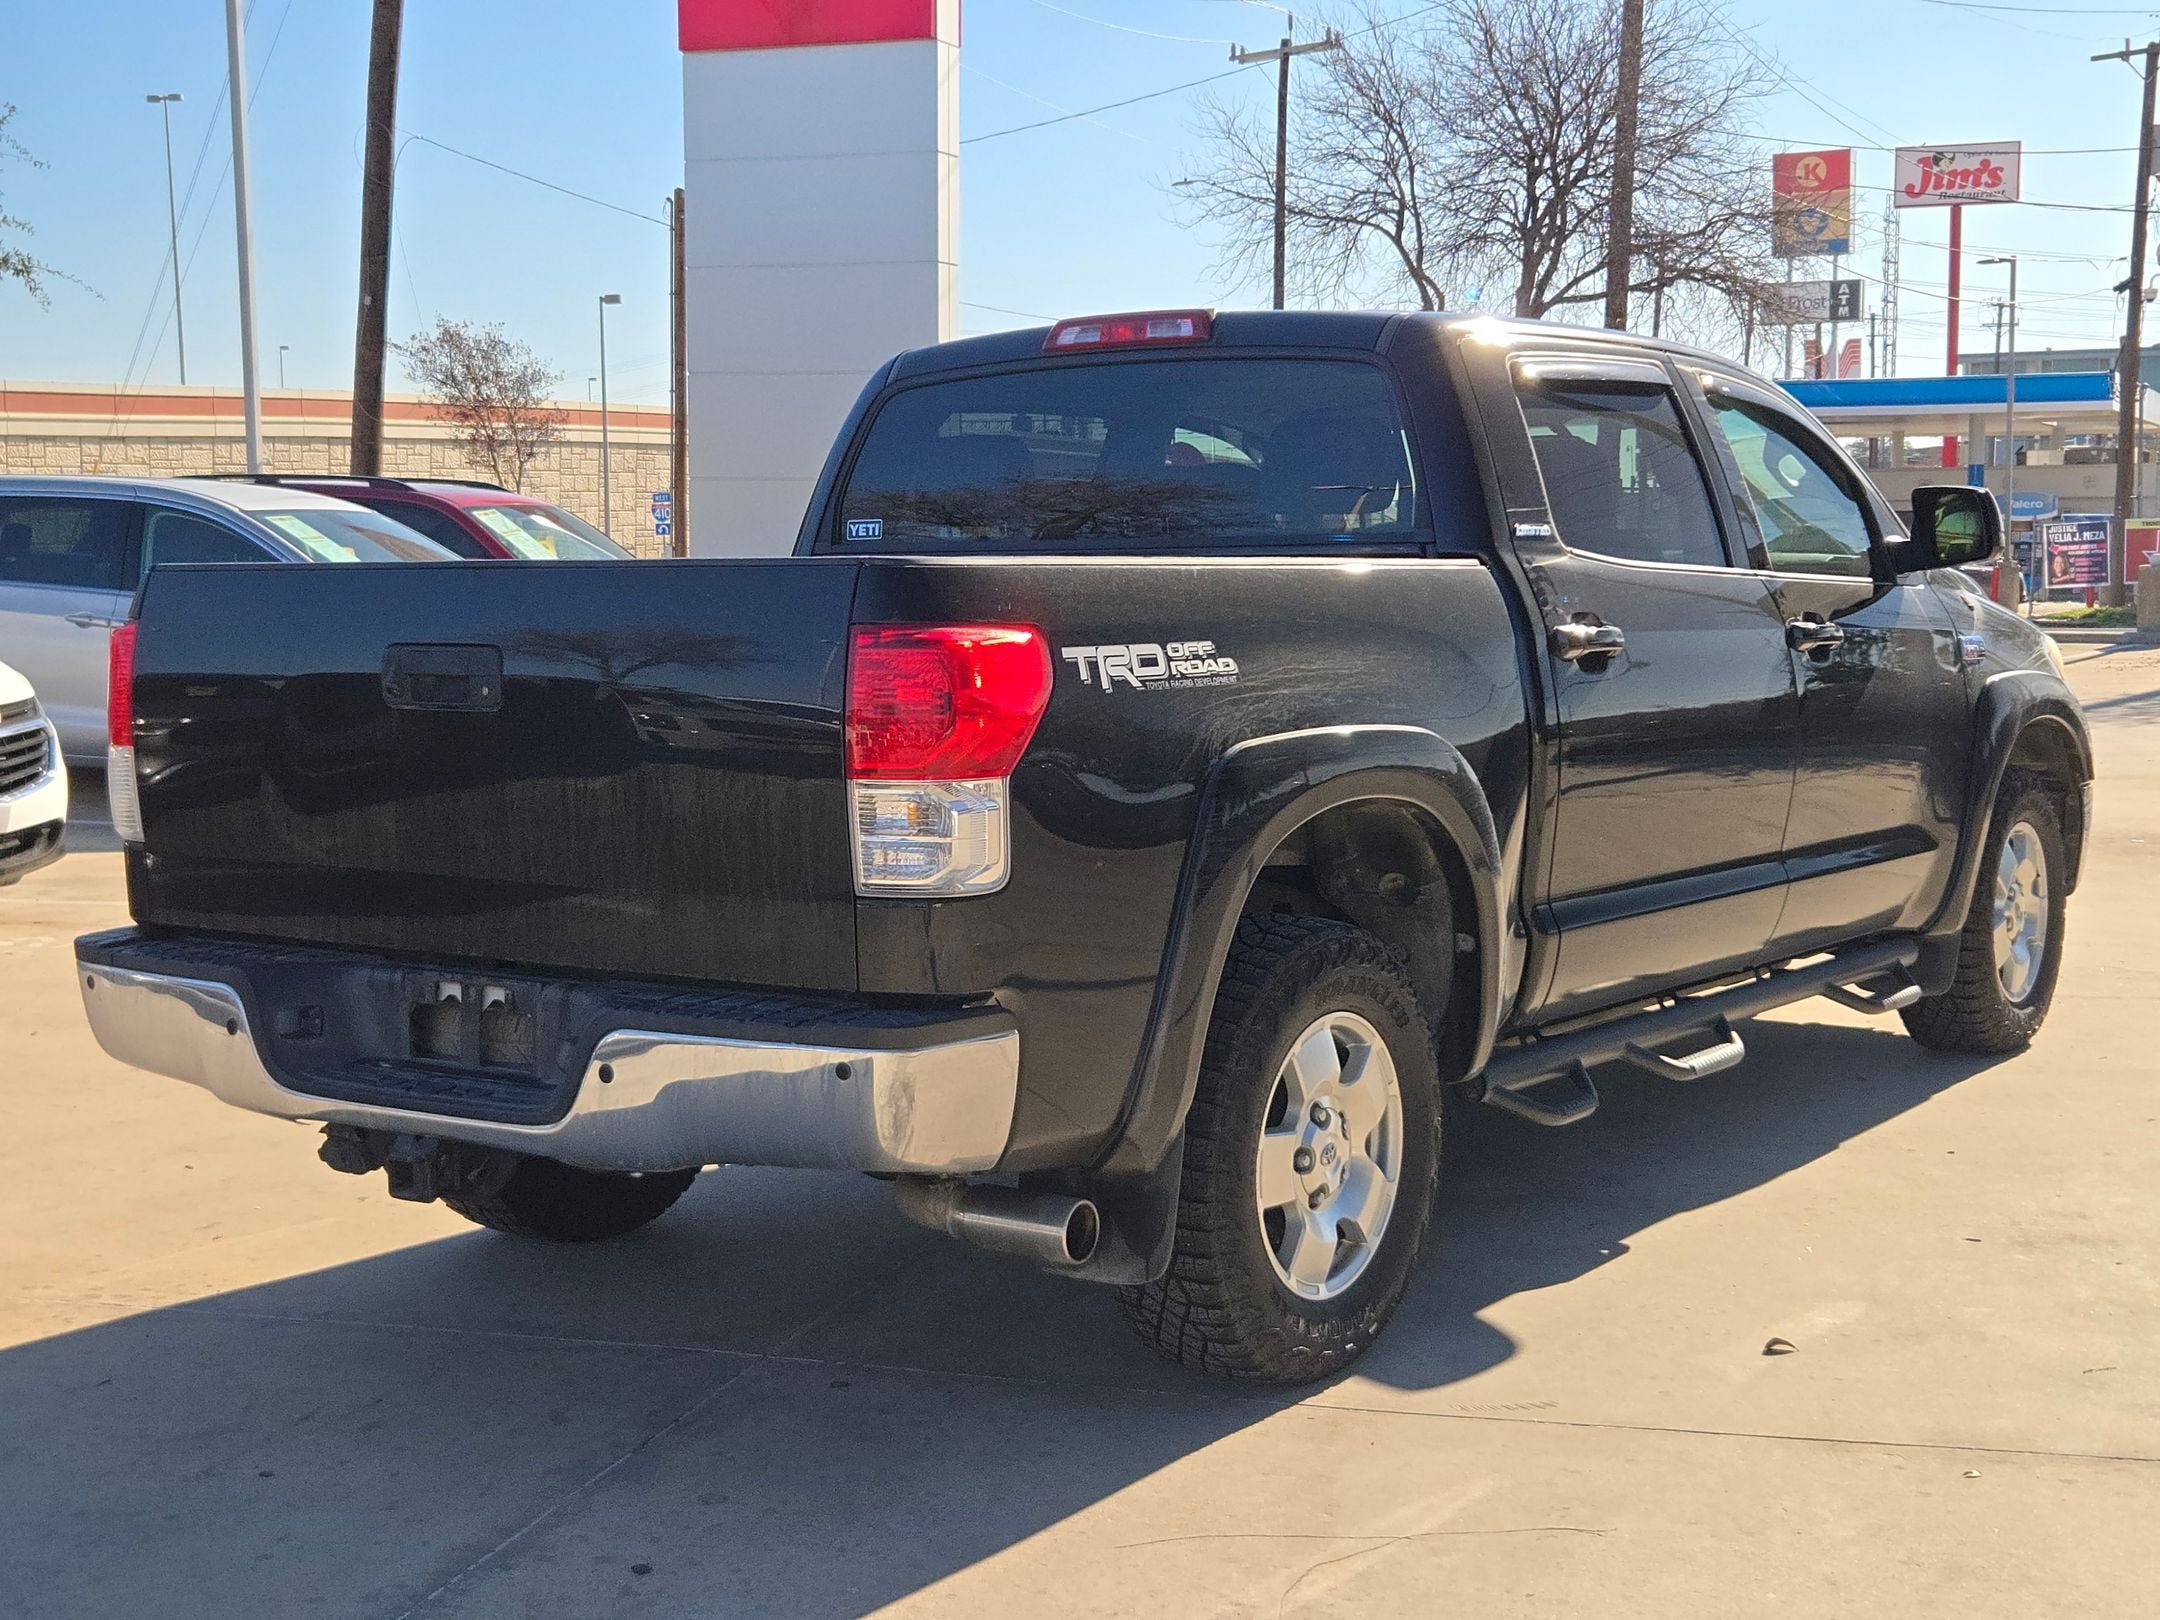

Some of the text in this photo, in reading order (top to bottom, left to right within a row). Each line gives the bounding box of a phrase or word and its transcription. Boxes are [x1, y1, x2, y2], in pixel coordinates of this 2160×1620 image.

[1804, 162, 1826, 184] K
[1904, 156, 2004, 199] Jim's
[1938, 189, 2005, 200] Restaurant
[1838, 283, 1850, 317] ATM
[2010, 499, 2043, 509] alero
[654, 508, 670, 519] 410
[850, 523, 880, 536] YETI
[2049, 525, 2077, 533] JUSTICE
[2073, 532, 2081, 541] J.
[2083, 530, 2105, 540] MEZA
[1166, 641, 1215, 659] OFF
[1062, 643, 1168, 693] TRD
[1170, 657, 1239, 678] ROAD
[1145, 676, 1238, 690] TOYOTA RACING DEVELOPMENT
